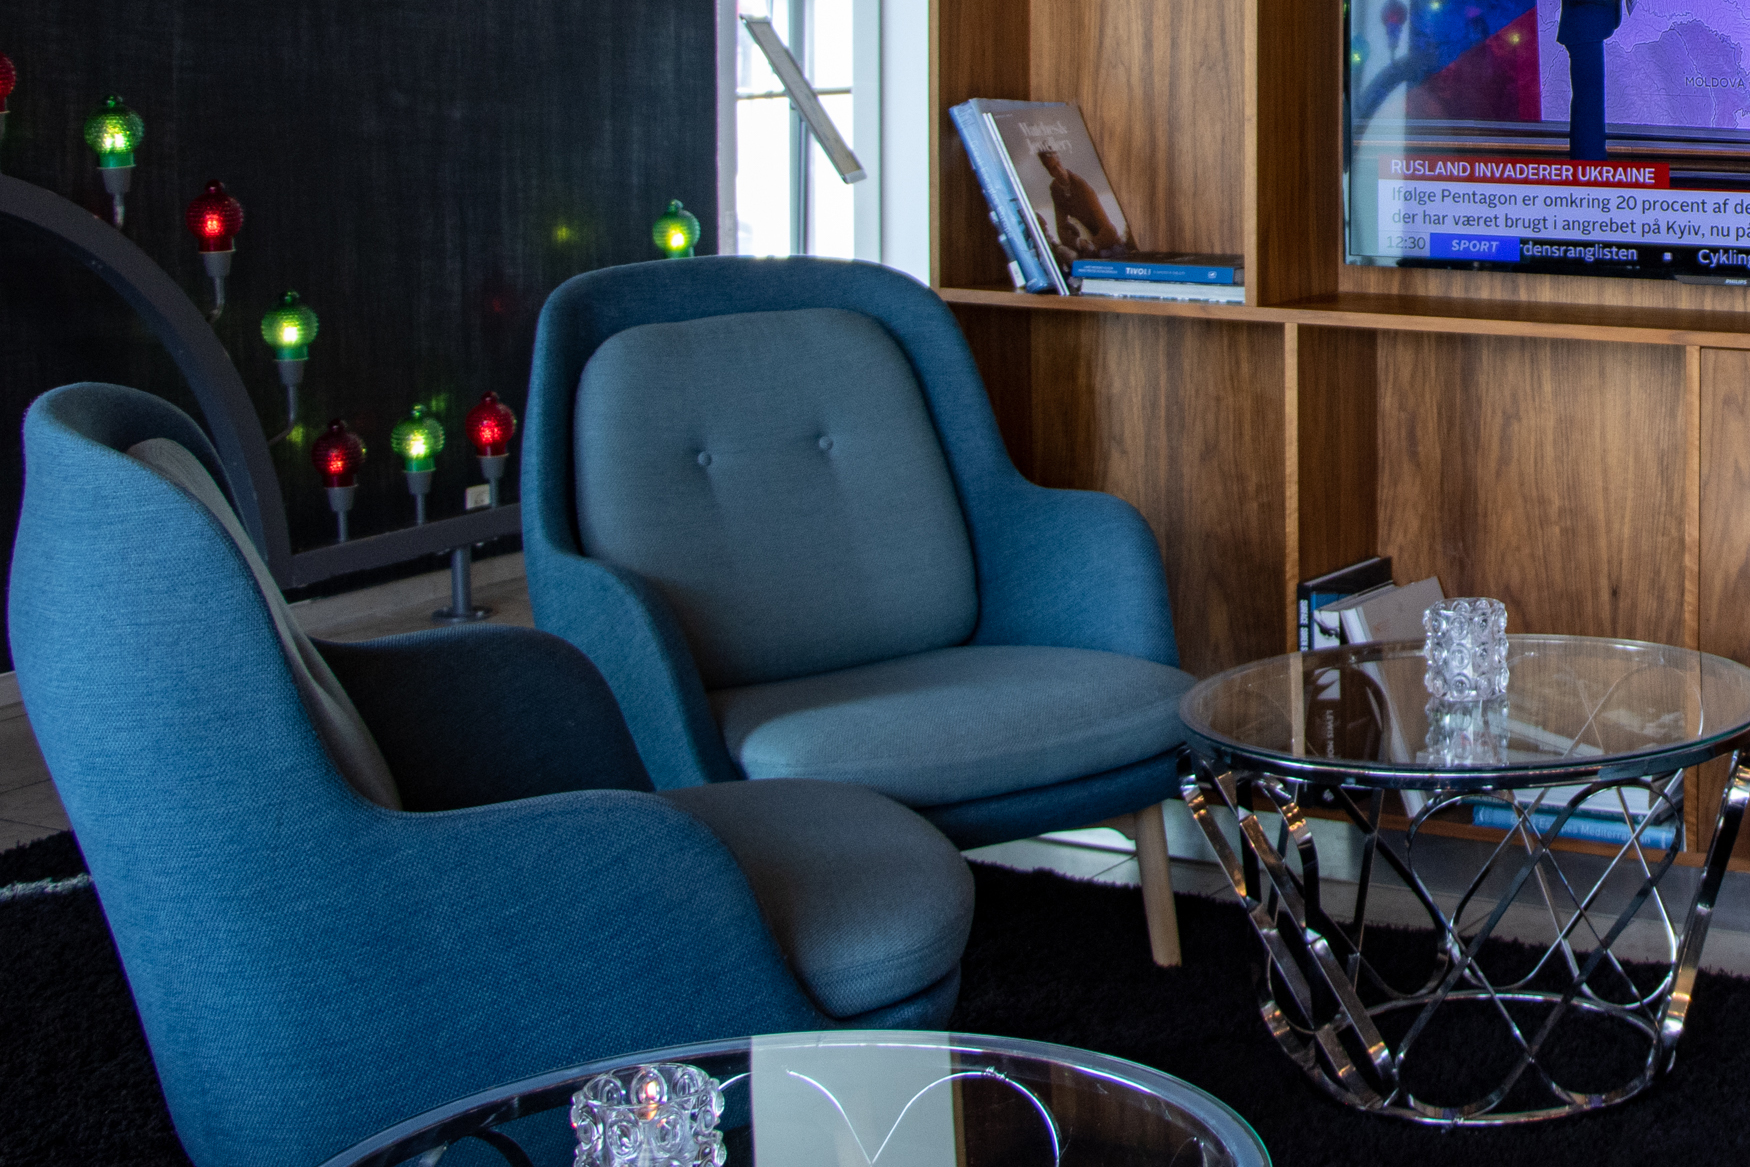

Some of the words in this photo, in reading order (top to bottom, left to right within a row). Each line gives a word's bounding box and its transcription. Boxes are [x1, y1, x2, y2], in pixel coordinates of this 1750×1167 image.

[1685, 76, 1746, 88] MOLDOVA
[1391, 159, 1471, 177] RUSLAND
[1475, 162, 1574, 181] INVADERER
[1577, 165, 1656, 184] UKRAINE
[1392, 186, 1437, 205] Ifølge
[1441, 188, 1517, 208] Pentagon
[1522, 194, 1539, 206] er
[1543, 192, 1612, 213] omkring
[1615, 195, 1637, 210] 20
[1641, 198, 1708, 214] procent
[1712, 198, 1730, 214] af
[1392, 209, 1418, 224] der
[1422, 210, 1448, 225] har
[1452, 213, 1500, 228] været
[1504, 213, 1548, 233] brugt
[1552, 215, 1558, 230] i
[1562, 217, 1636, 236] angrebet
[1641, 218, 1661, 237] på
[1666, 220, 1706, 239] Kyiv,
[1710, 225, 1730, 237] nu
[1386, 235, 1426, 250] 12:30
[1451, 239, 1500, 253] SPORT
[1520, 241, 1638, 263] densranglisten
